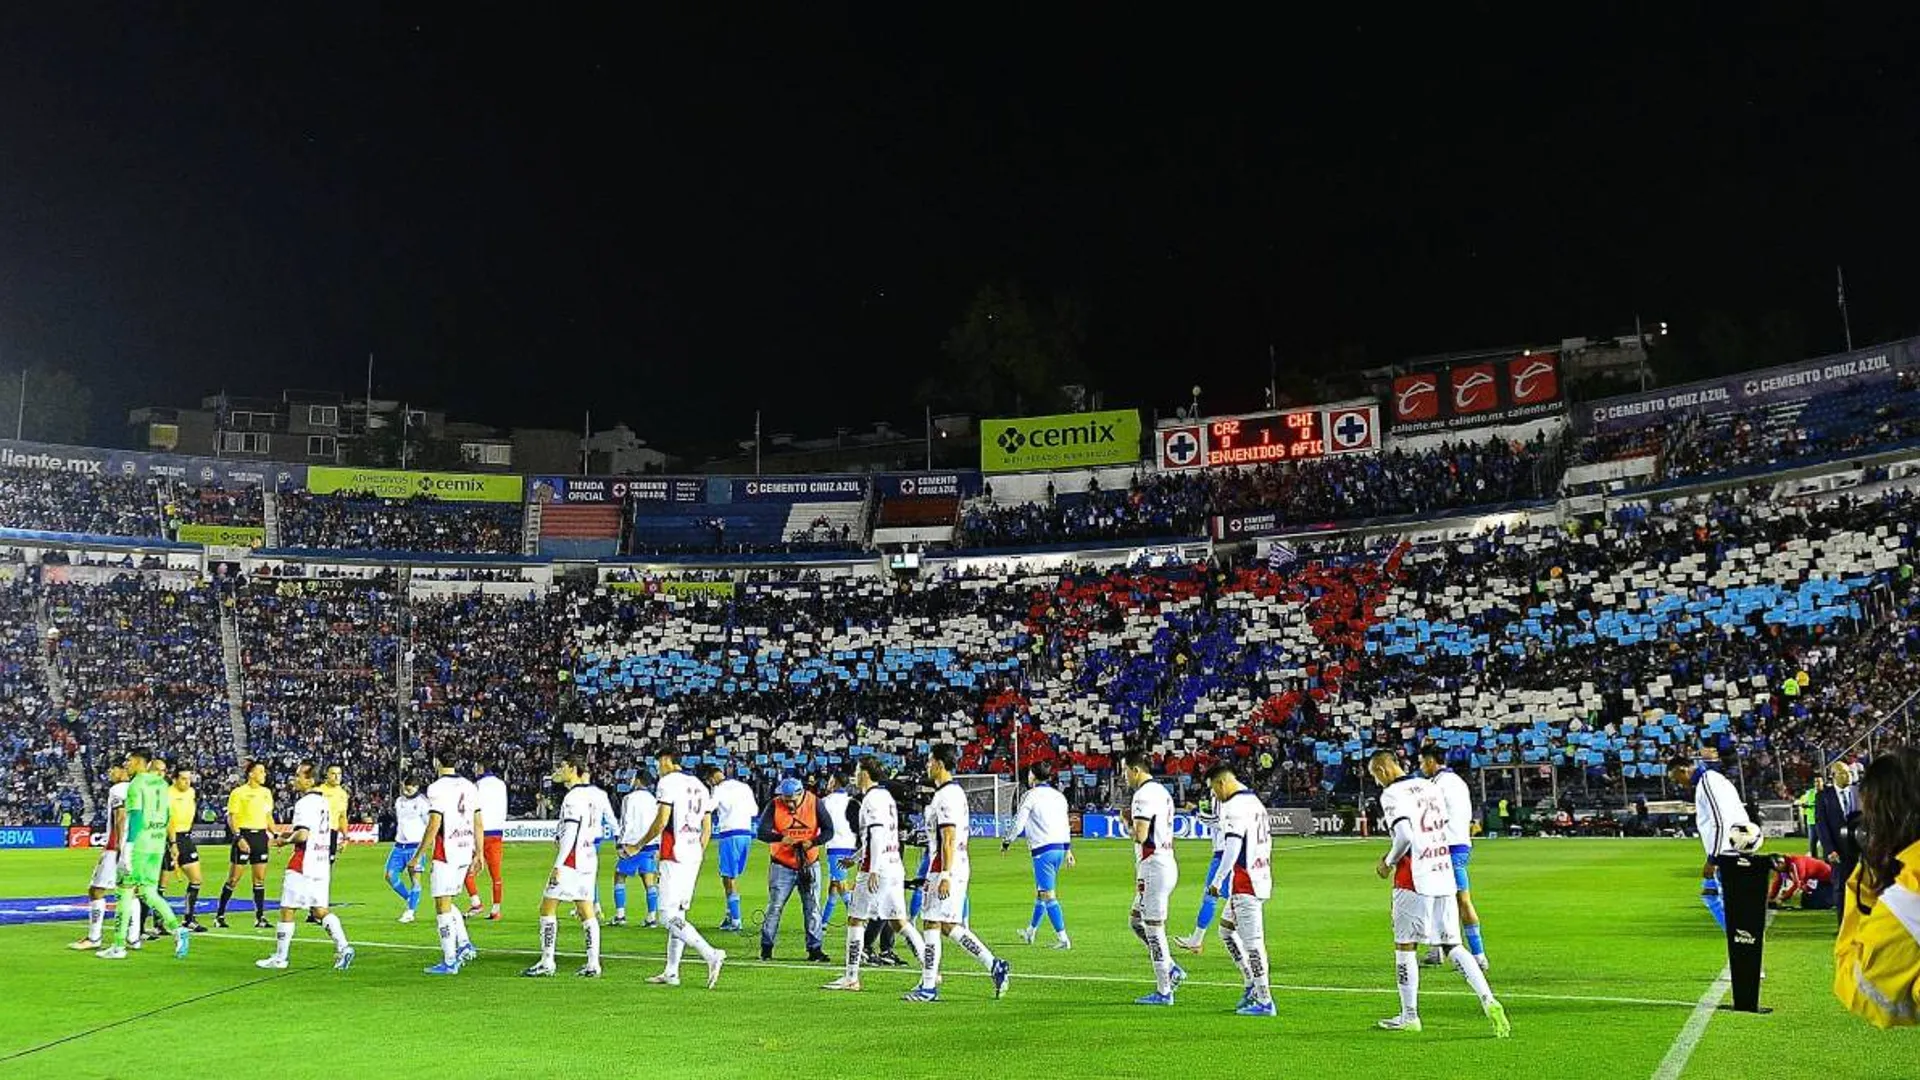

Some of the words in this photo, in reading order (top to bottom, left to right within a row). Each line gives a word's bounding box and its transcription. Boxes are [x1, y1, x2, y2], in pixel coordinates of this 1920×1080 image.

[1761, 369, 1821, 392] CEMENTO
[1824, 362, 1858, 381] CRUZ
[1858, 355, 1890, 373] AZUL
[1508, 401, 1563, 418] caliente.mx
[1608, 399, 1664, 419] CEMENTO
[1668, 391, 1698, 408] CRUZ
[1699, 387, 1730, 404] AZUL
[1213, 421, 1240, 435] CAZ
[1288, 413, 1314, 428] CHI
[1449, 412, 1504, 426] caliente.mx
[1391, 420, 1445, 433] caliente.mx
[1029, 421, 1116, 448] cemix
[437, 479, 485, 492] cemix
[569, 481, 604, 490] TIENDA
[918, 475, 958, 485] CEMENTO
[760, 482, 807, 493] CEMENTO
[810, 482, 835, 492] CRUZ
[836, 481, 860, 492] AZUL
[568, 491, 604, 501] OFICIAL
